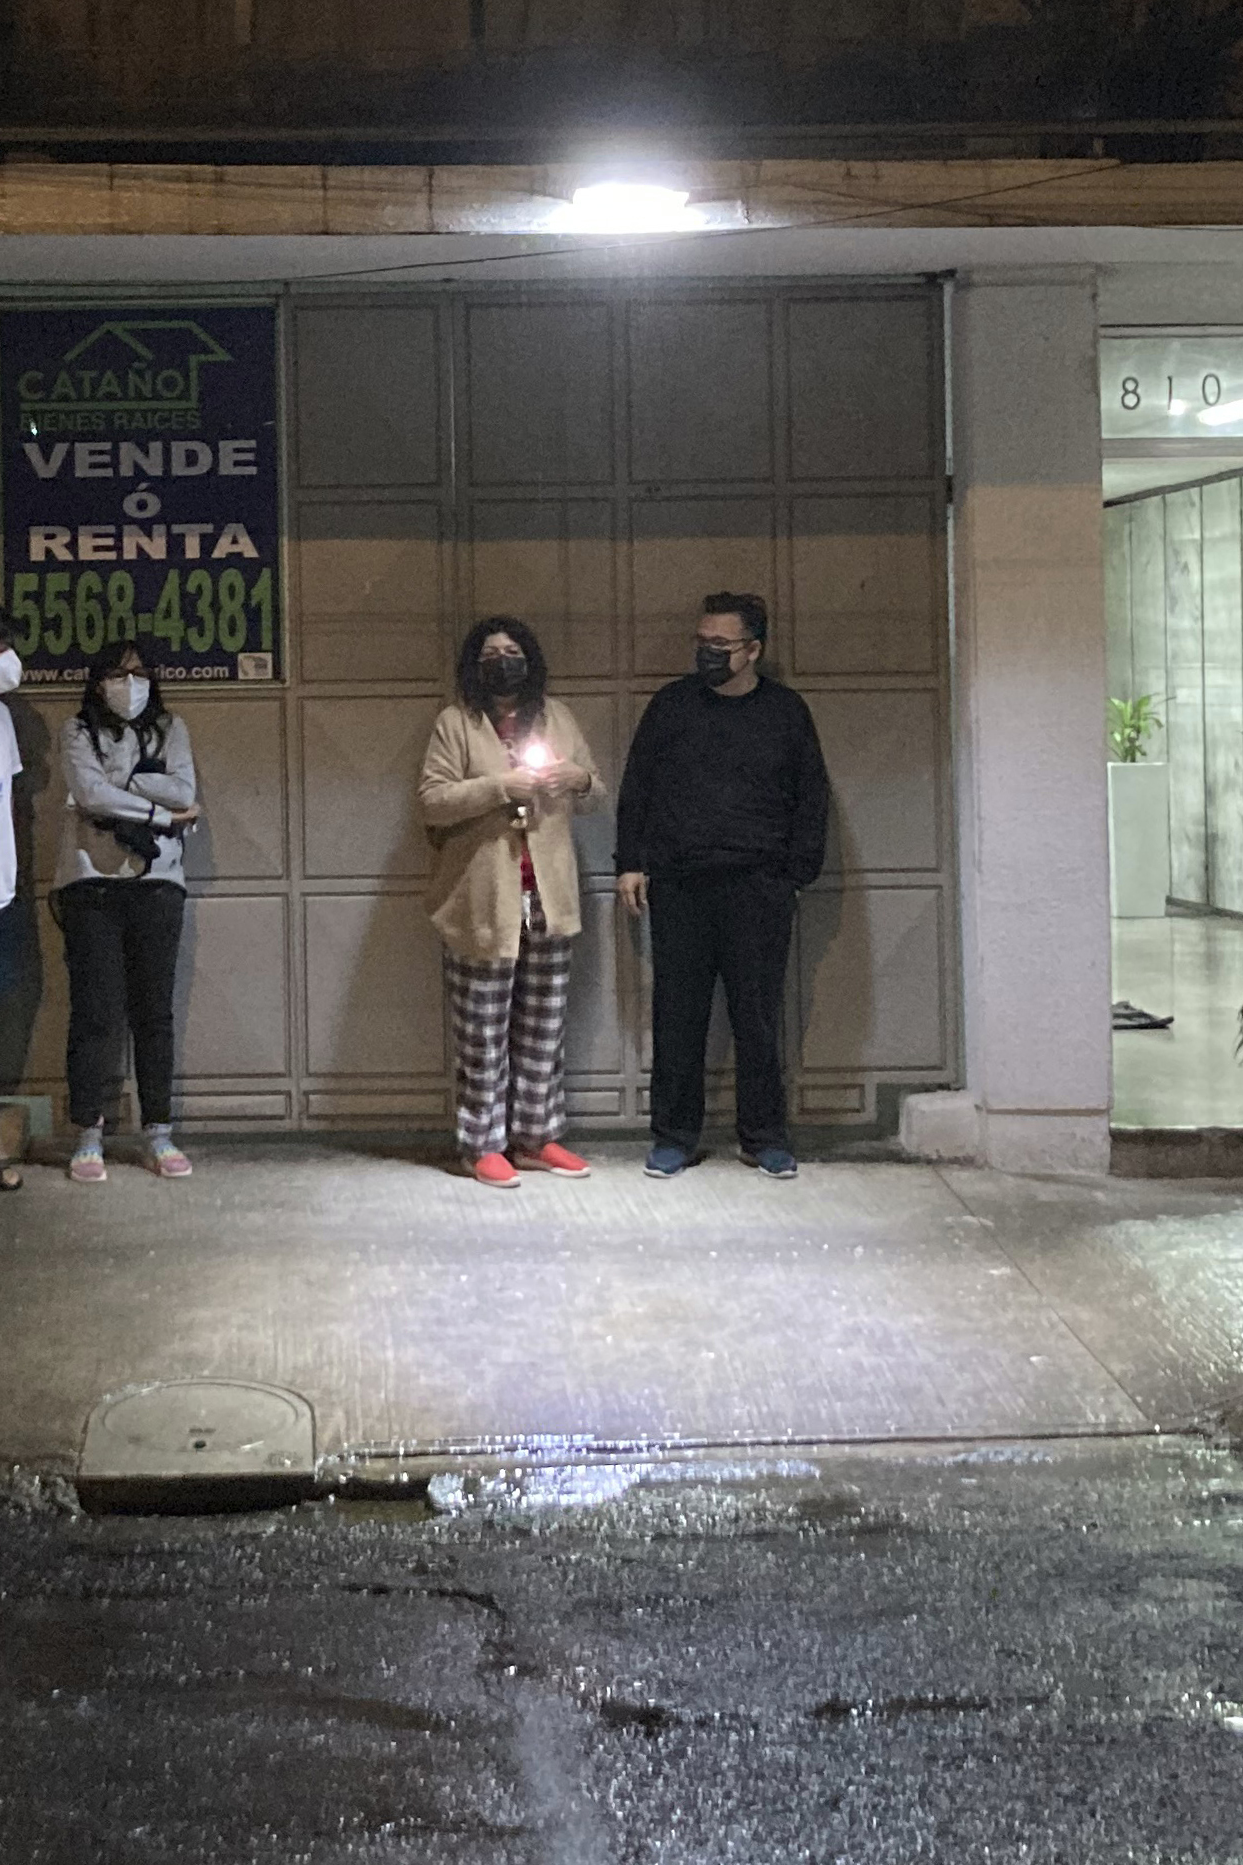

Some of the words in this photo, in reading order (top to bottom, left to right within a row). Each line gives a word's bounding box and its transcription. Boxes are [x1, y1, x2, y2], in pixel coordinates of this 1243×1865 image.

[17, 361, 186, 400] CATAÑO
[1120, 373, 1222, 411] 810
[20, 412, 106, 431] BIENES
[23, 439, 257, 479] VENDE
[122, 482, 162, 519] Ó
[28, 522, 260, 562] RENTA
[12, 567, 273, 655] 5568-4381
